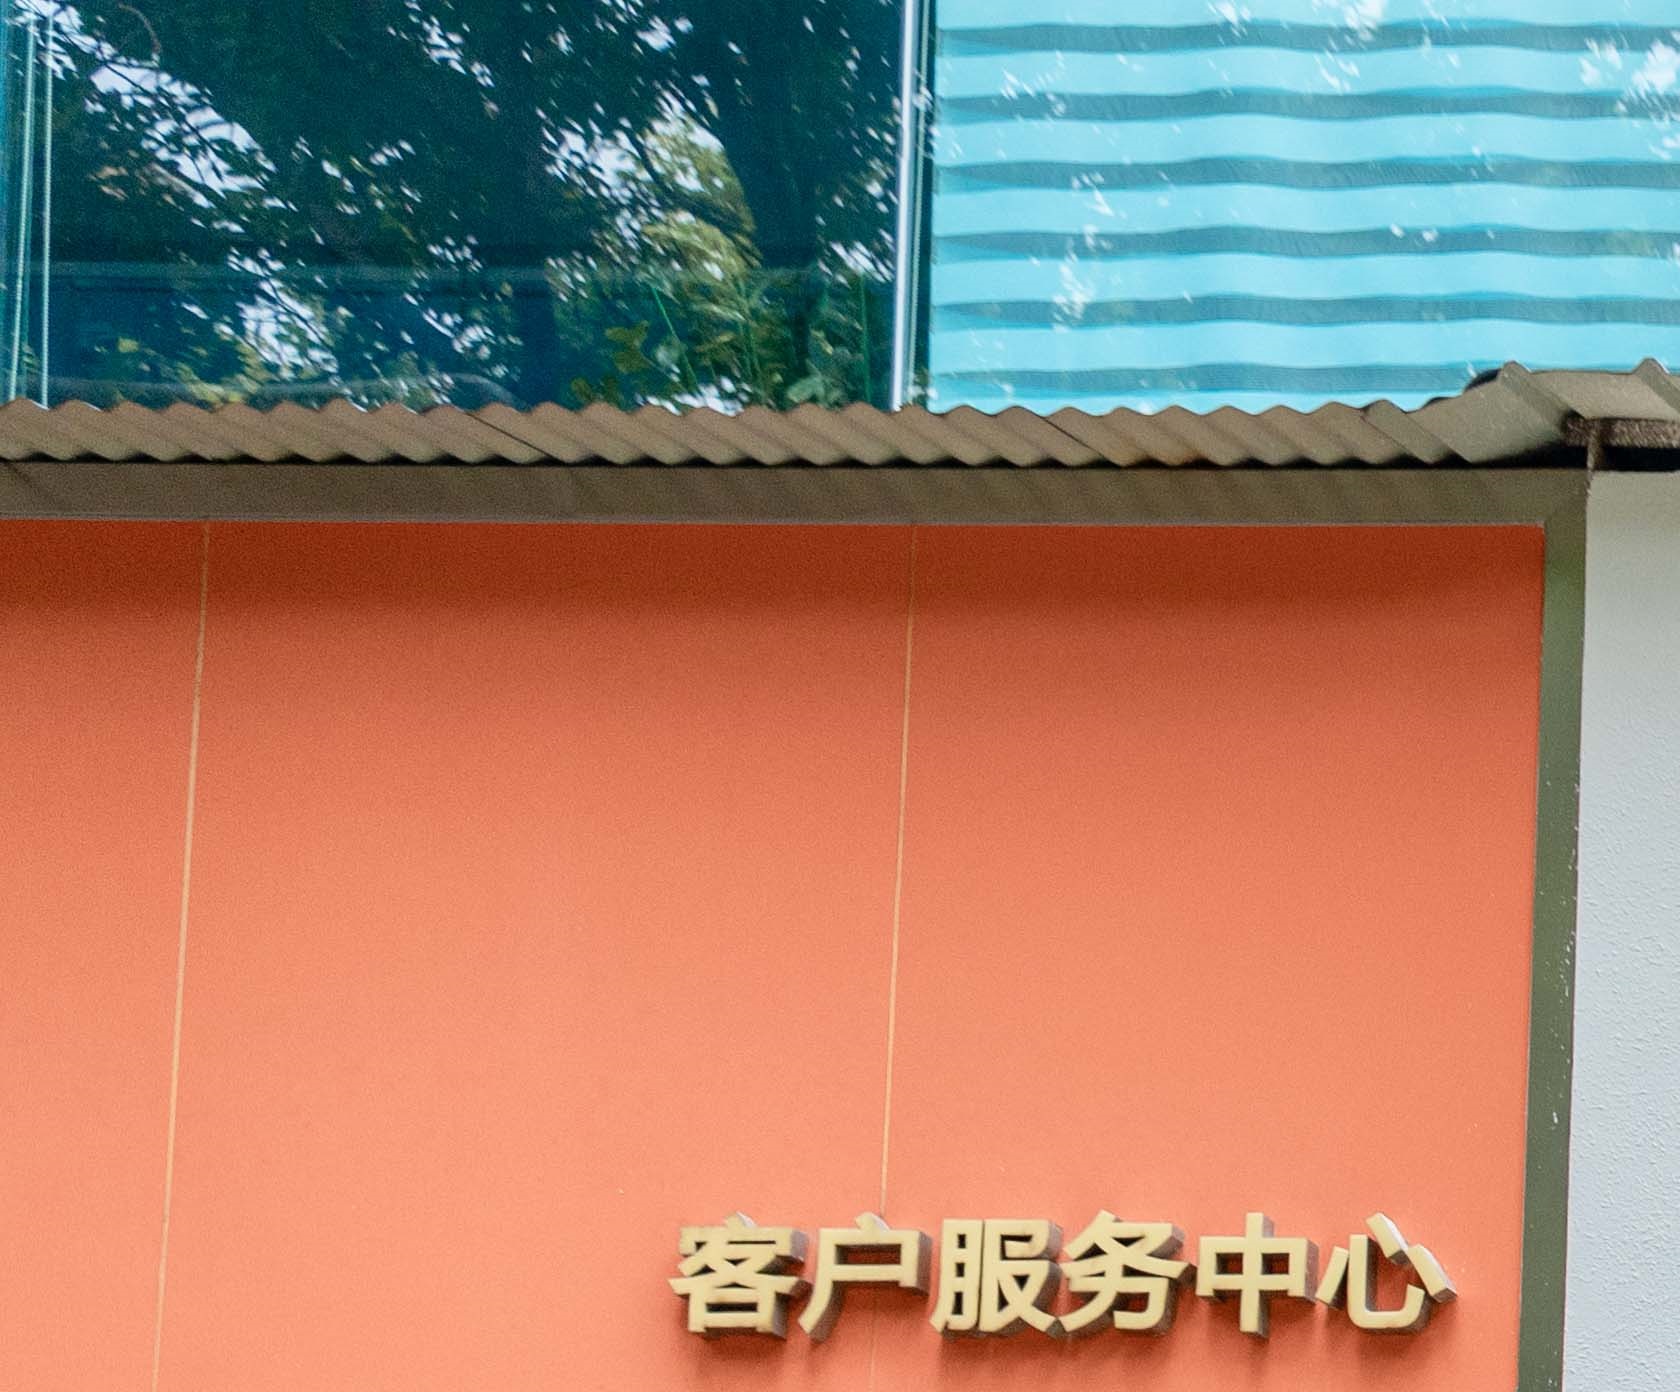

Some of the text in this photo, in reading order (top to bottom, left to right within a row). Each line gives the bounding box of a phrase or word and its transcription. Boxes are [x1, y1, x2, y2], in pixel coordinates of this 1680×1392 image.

[668, 1209, 1458, 1340] 客户服务中心
